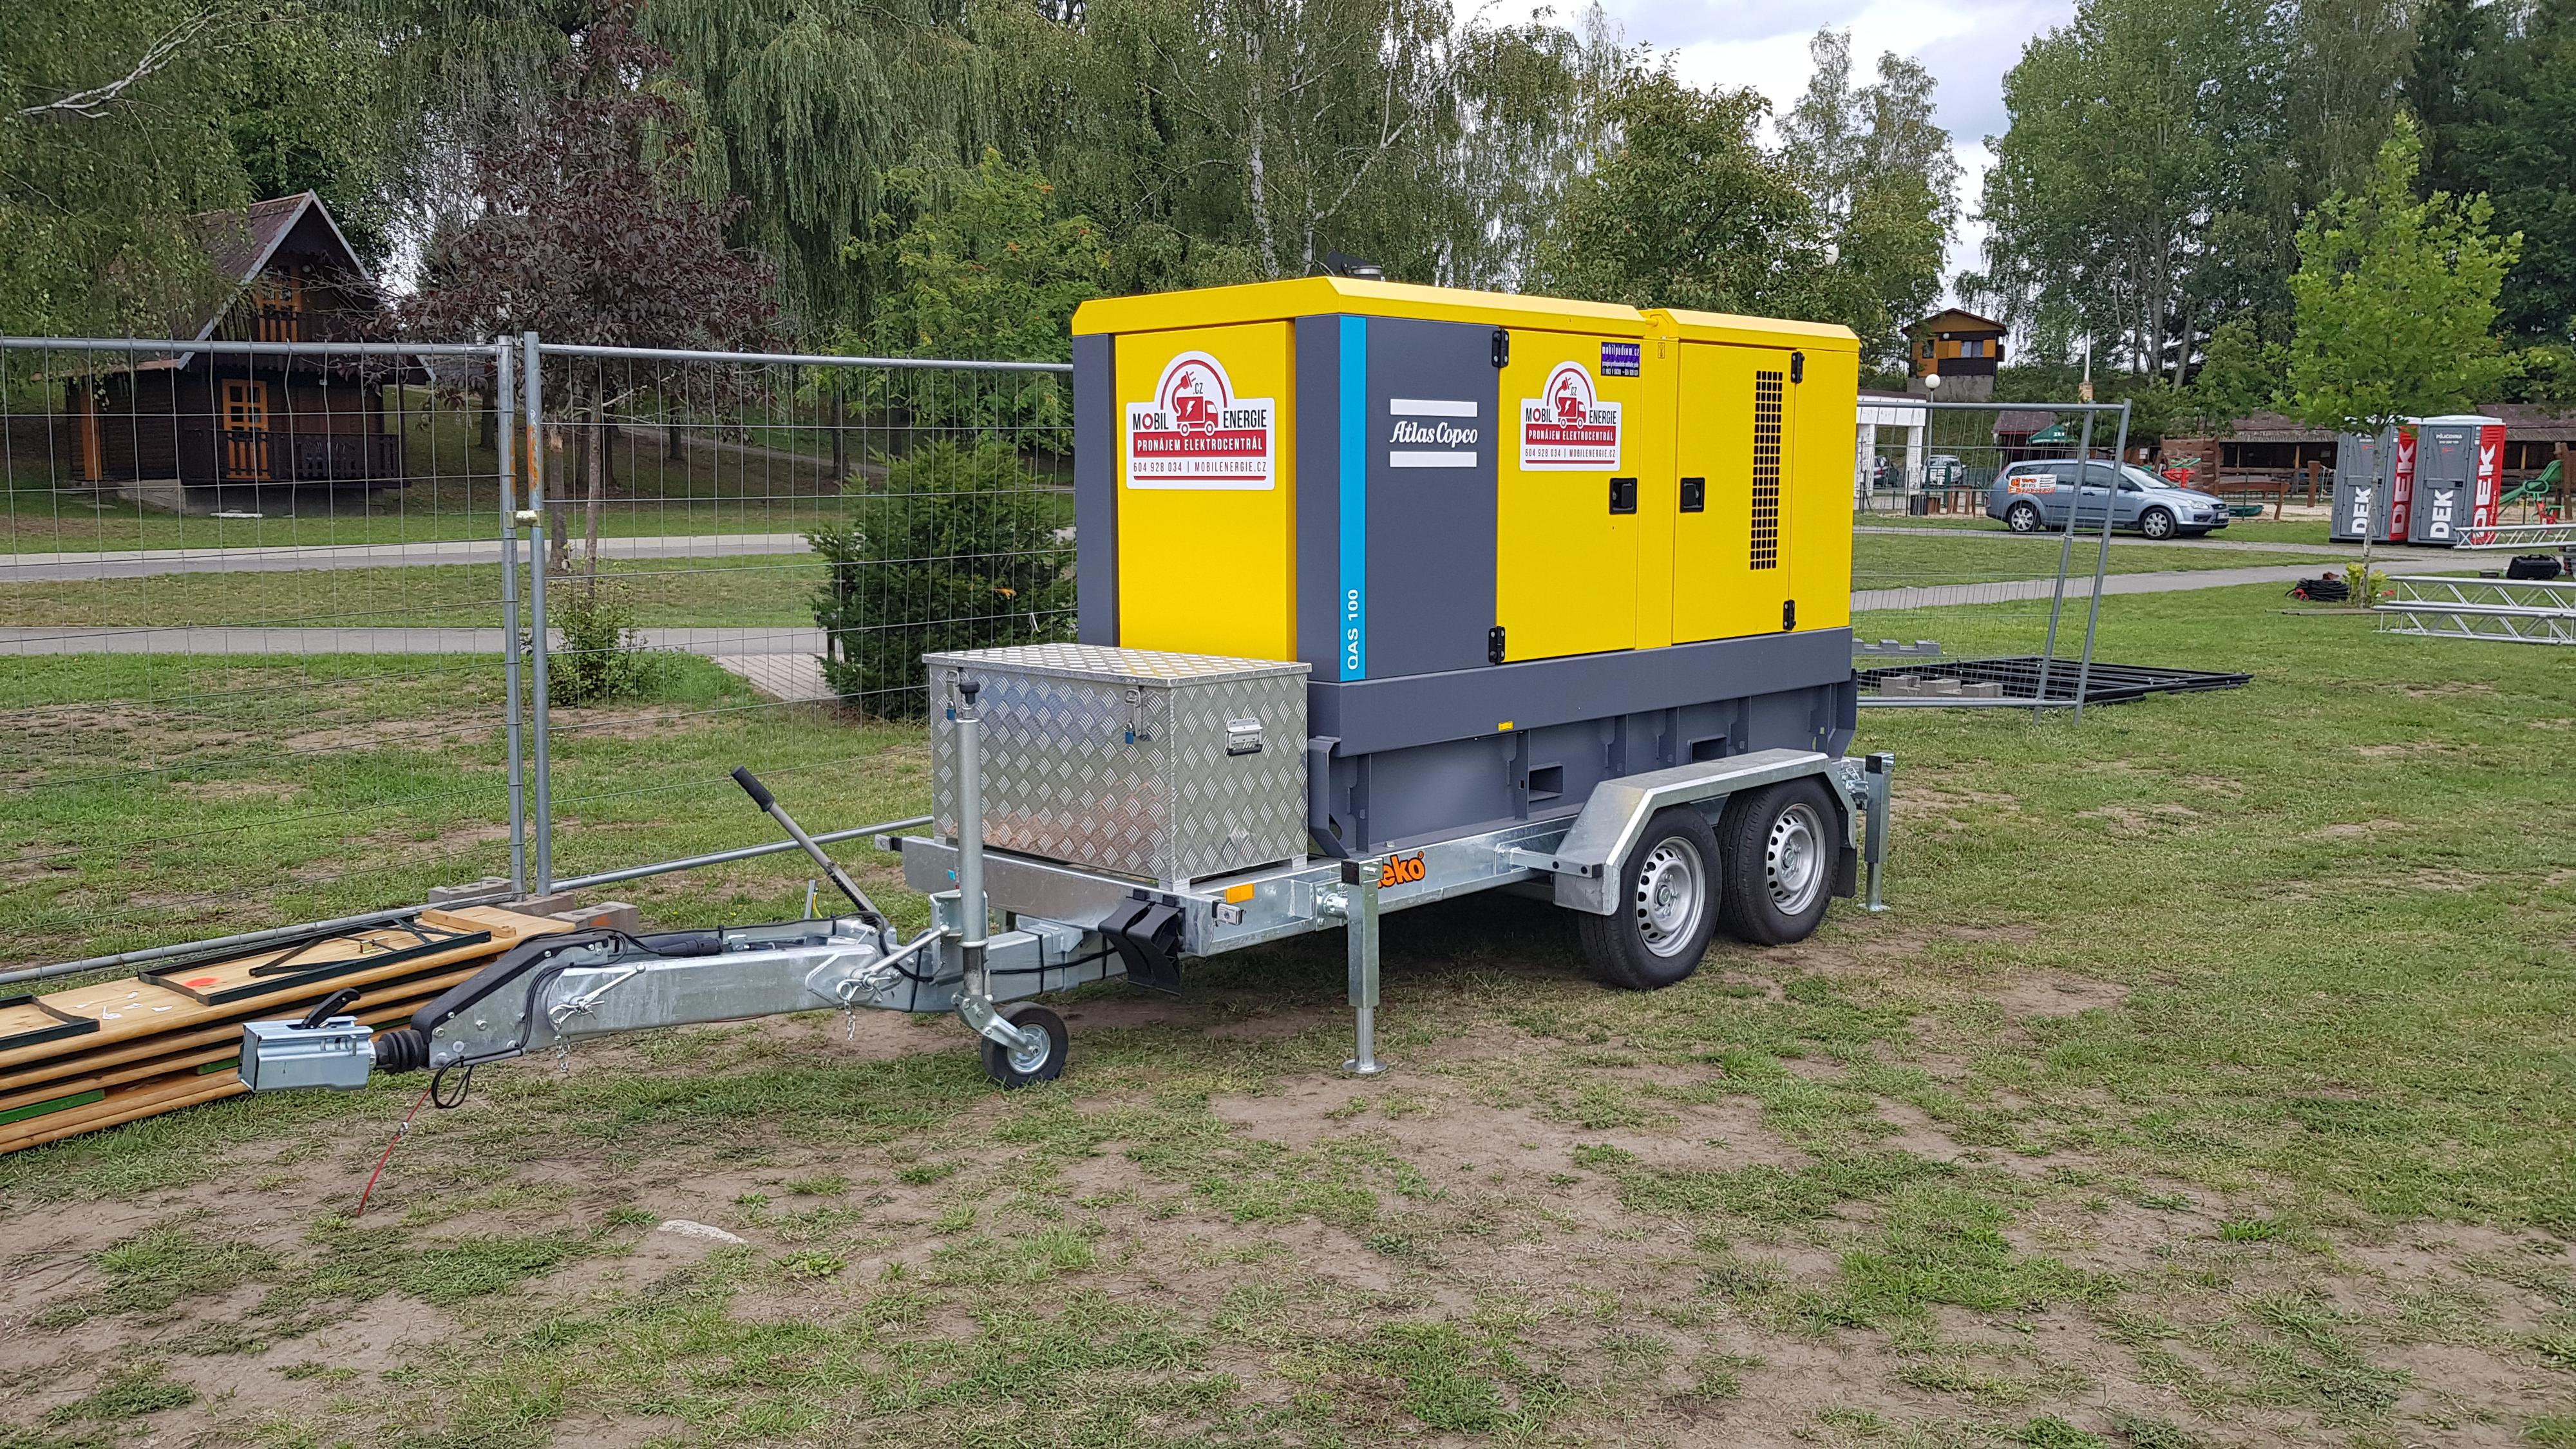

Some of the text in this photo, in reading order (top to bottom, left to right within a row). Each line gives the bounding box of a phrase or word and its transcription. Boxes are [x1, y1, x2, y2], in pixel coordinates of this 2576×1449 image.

[1193, 383, 1204, 395] .CZ
[1133, 409, 1267, 431] MOBIL ENERGIE
[1526, 408, 1617, 424] MOBIL ENERGIE
[1137, 435, 1263, 451] PRONÁJEM ELEKTROCENTRÁL
[1389, 421, 1478, 448] Atlas Copco
[1528, 429, 1614, 441] PRONÁJEM ELEKTROCENTRÁL
[1525, 448, 1615, 458] 604 928 034 MOBILENERGIE.CZ
[1133, 461, 1267, 472] 604 928 034 MOBILENERGIE.CZ
[2391, 441, 2414, 534] DEK
[2351, 486, 2372, 534] DEK
[2430, 489, 2454, 538] DEK
[1347, 589, 1358, 670] QAS 100
